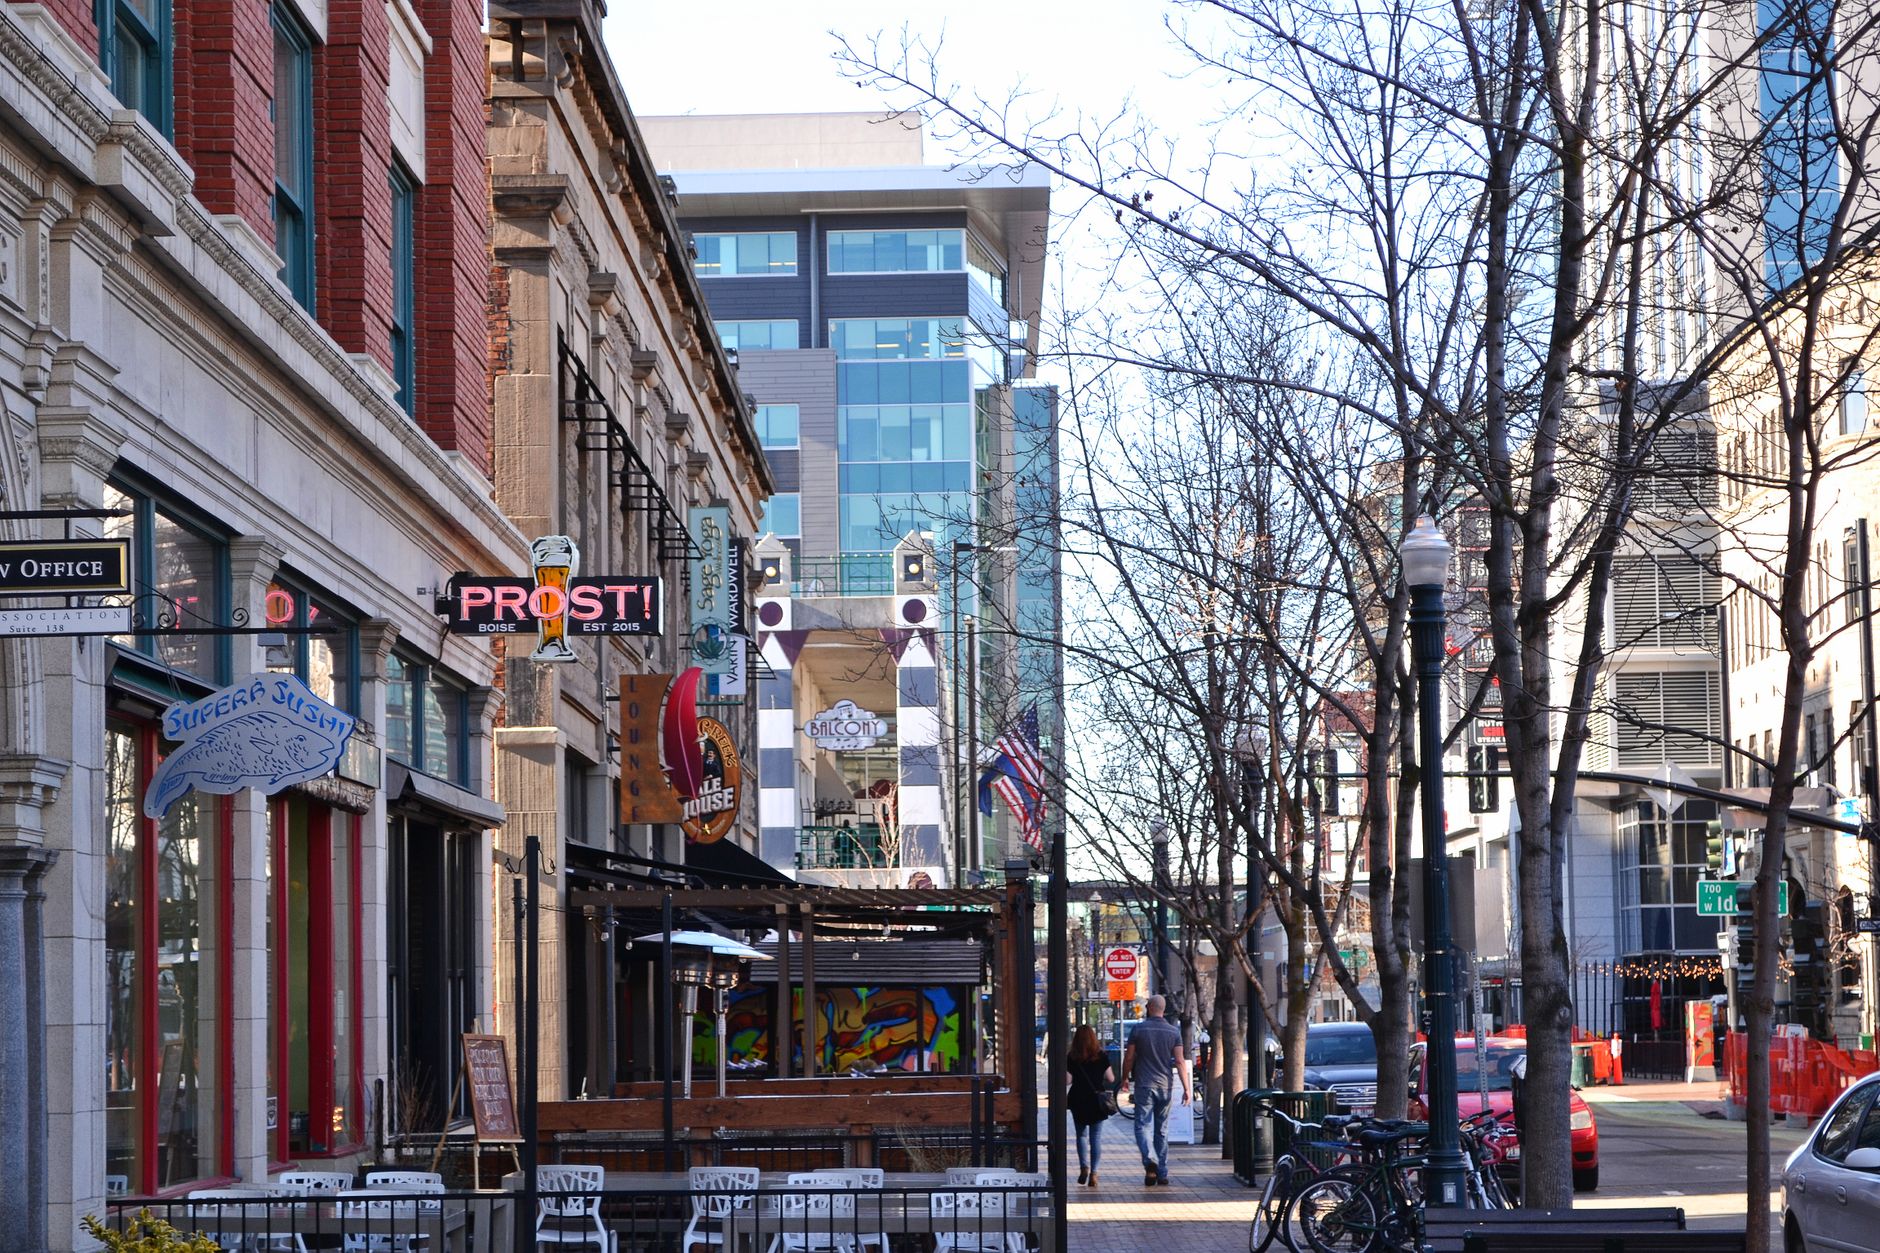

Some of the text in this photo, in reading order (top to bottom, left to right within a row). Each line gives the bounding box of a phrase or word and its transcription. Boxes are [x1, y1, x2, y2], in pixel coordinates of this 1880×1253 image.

[20, 559, 103, 578] OFFICE
[697, 564, 722, 612] Sage
[459, 584, 653, 621] PROST!
[9, 624, 64, 633] Suite 138
[478, 623, 516, 632] BOISE
[583, 622, 640, 631] EST 2015
[168, 681, 345, 737] SUPERB SUSHI
[810, 721, 880, 736] BALCONY
[628, 676, 641, 823] LOUNGE
[697, 718, 738, 768] CREEK
[1704, 884, 1721, 893] 700
[1704, 902, 1713, 912] W
